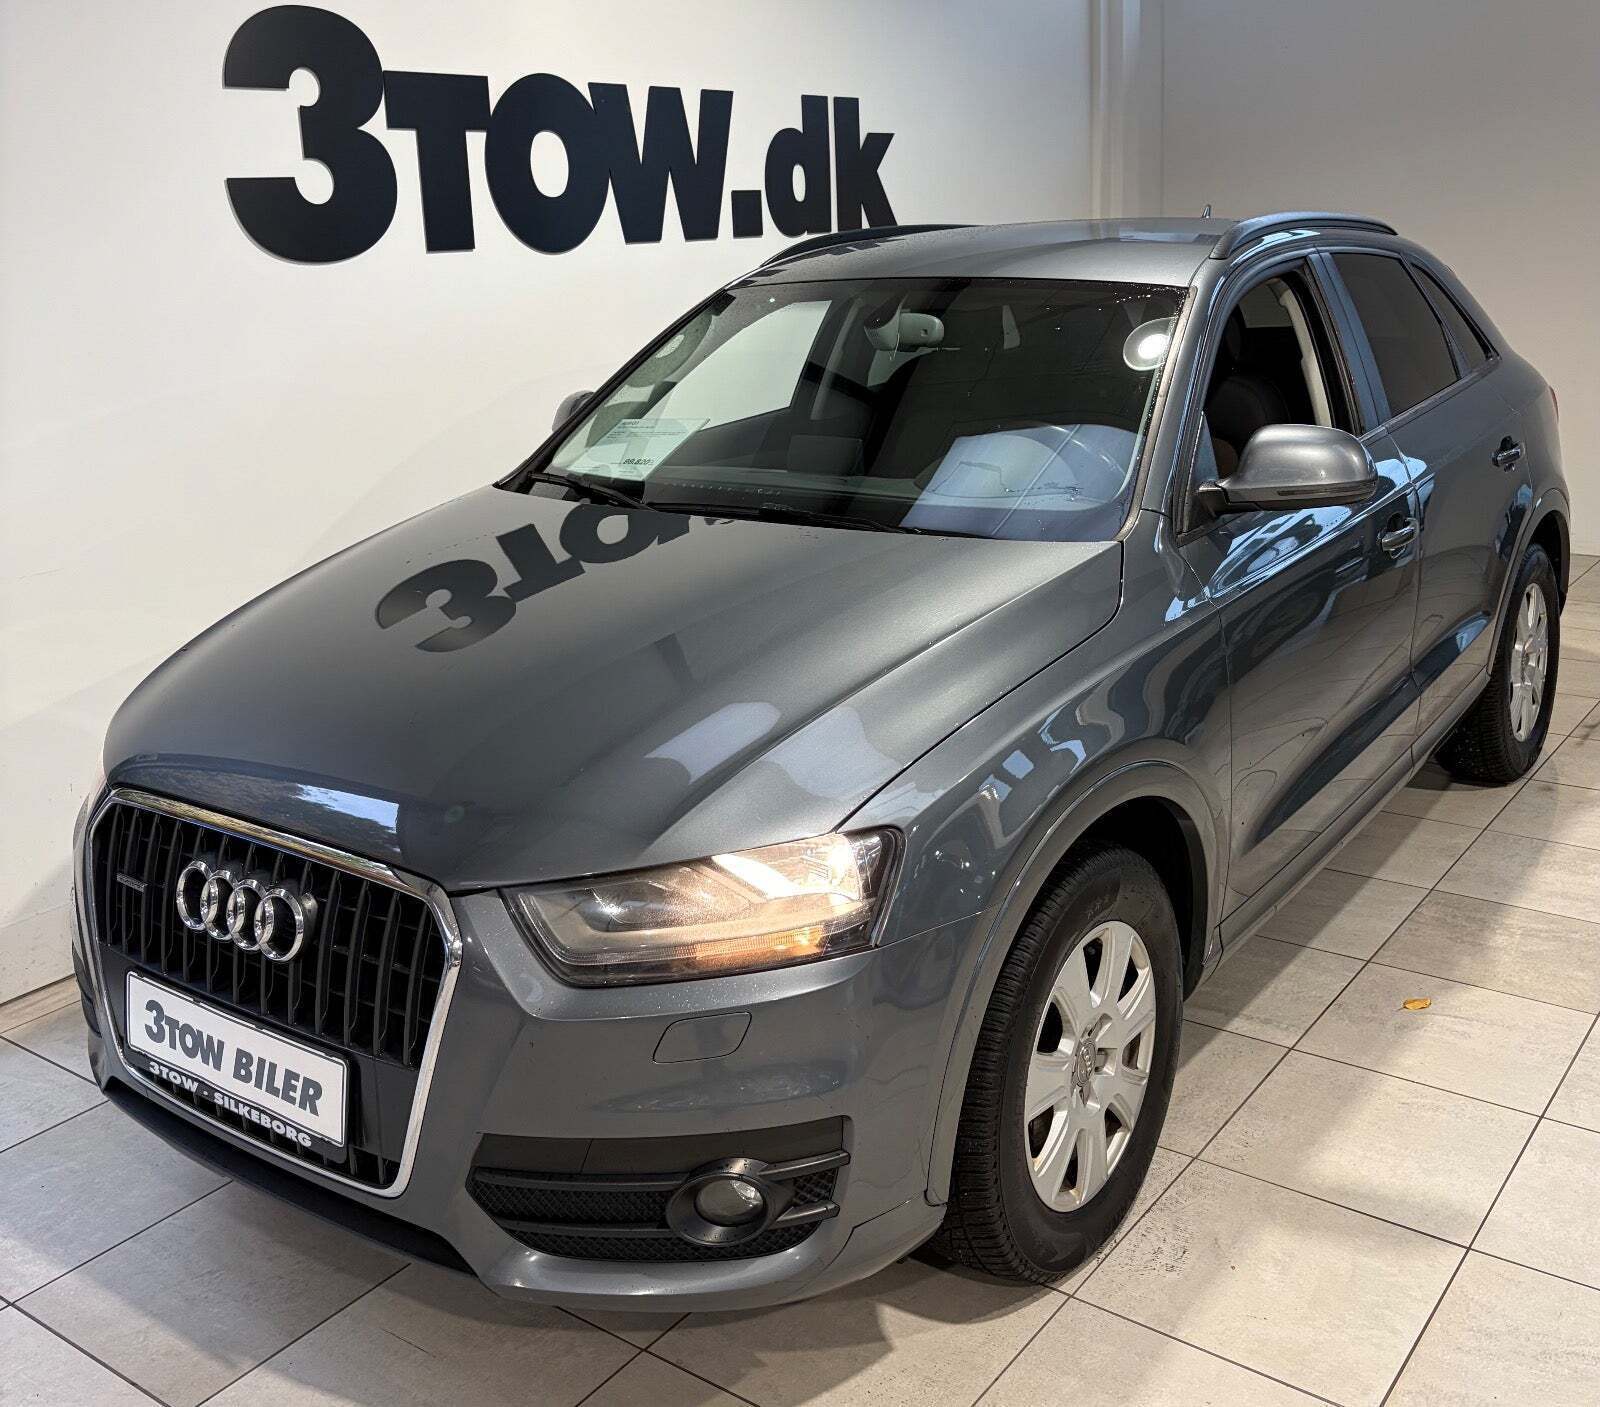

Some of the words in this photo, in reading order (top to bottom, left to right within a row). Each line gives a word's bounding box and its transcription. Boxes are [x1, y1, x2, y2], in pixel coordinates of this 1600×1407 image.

[223, 5, 897, 264] 3TOW.dk
[145, 1000, 225, 1071] 3TOW
[233, 1048, 322, 1117] BILER
[149, 1062, 199, 1092] 3TOW
[214, 1093, 312, 1147] SILKEBORG
